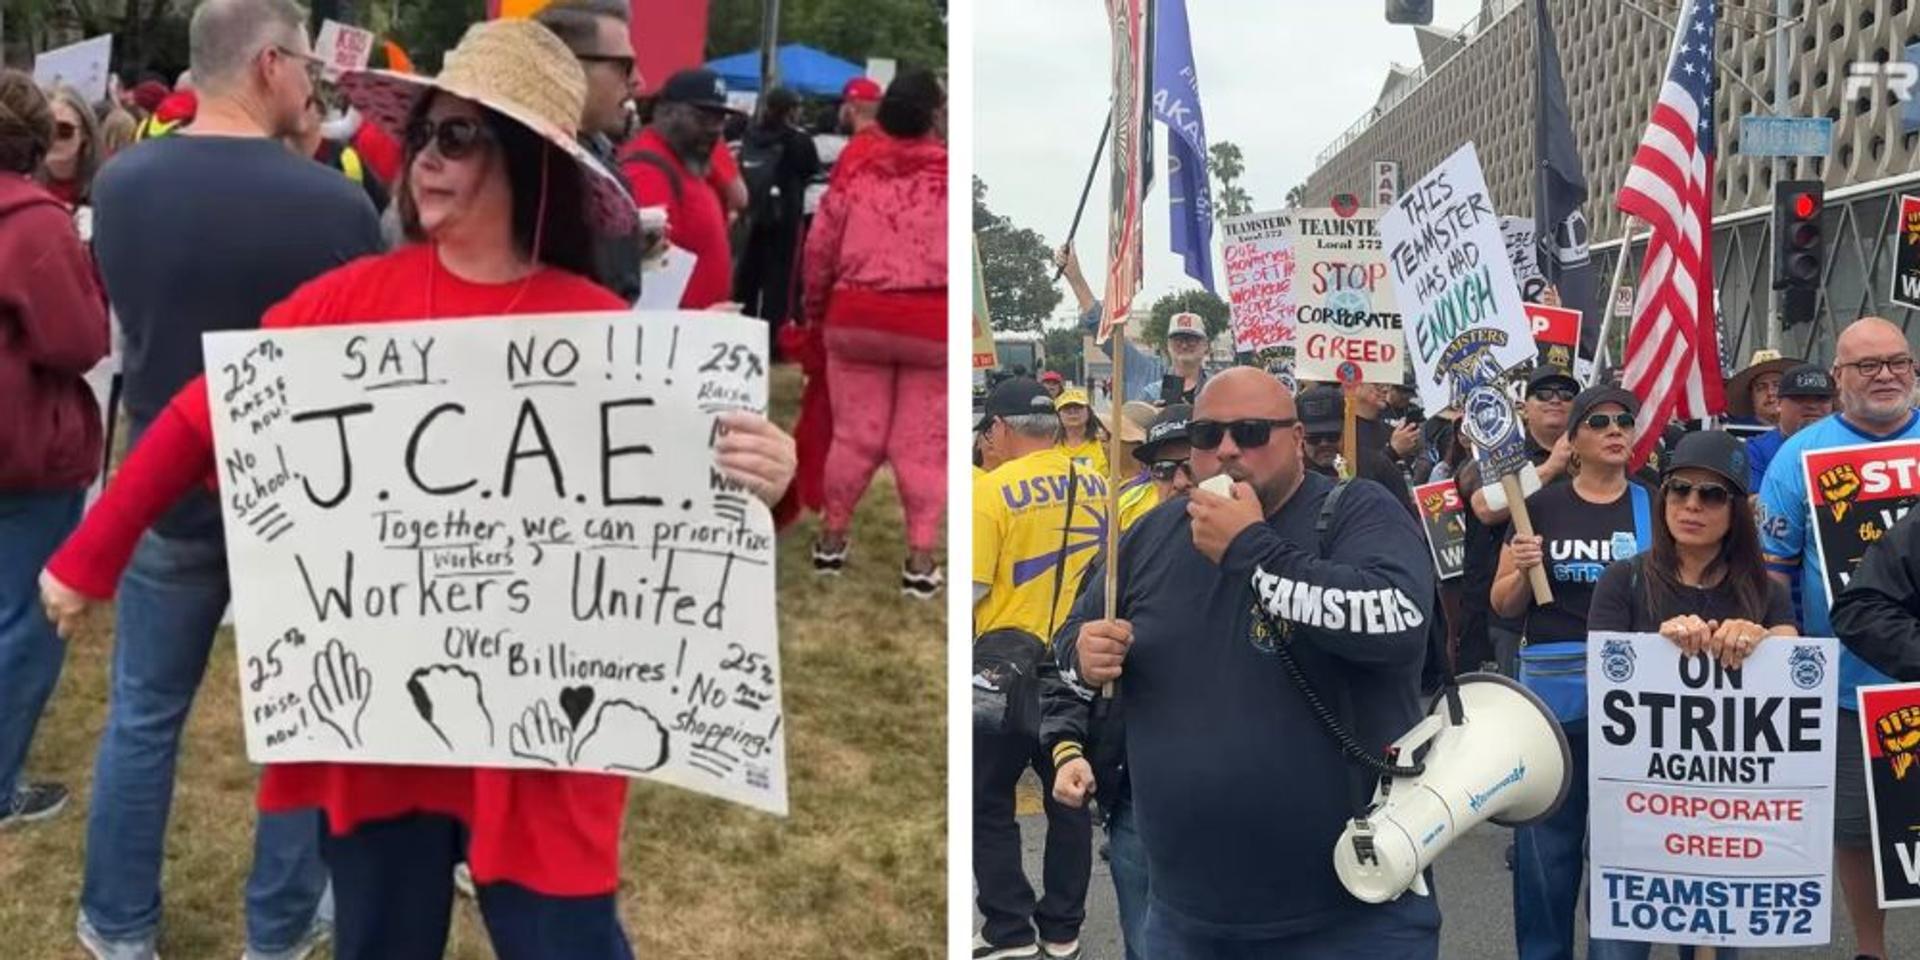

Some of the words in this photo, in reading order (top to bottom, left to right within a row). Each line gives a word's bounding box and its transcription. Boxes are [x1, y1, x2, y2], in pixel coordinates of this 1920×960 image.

[1379, 163, 1393, 205] PAR
[1400, 171, 1453, 226] THIS
[1225, 215, 1292, 236] TEAMSTERS
[1300, 218, 1381, 238] TEAMSTE
[1391, 192, 1492, 286] TEAMSTER
[1317, 239, 1352, 250] Local
[1356, 238, 1383, 250] 572
[1312, 260, 1387, 296] STOP
[1415, 265, 1447, 306] HAS
[1447, 241, 1480, 280] HAD
[1297, 304, 1402, 330] CORPORATE
[1415, 264, 1498, 363] ENOUGH
[342, 335, 435, 381] SAY
[1306, 333, 1396, 363] GREED
[226, 448, 256, 486] No
[291, 397, 692, 510] J.C.A.E.
[1860, 458, 1920, 493] ST
[522, 516, 573, 543] we
[584, 515, 635, 542] can
[653, 510, 771, 560] prioritize
[1859, 521, 1882, 542] the
[1551, 539, 1611, 561] UNI
[294, 547, 530, 622] Workers
[571, 549, 734, 630] United
[1553, 561, 1606, 583] STR
[508, 636, 687, 695] Billionaires!
[1678, 648, 1743, 690] ON
[688, 672, 726, 709] No
[1601, 689, 1822, 752] STRIKE
[1647, 752, 1775, 784] AGAINST
[1626, 791, 1804, 822] CORPORATE
[1664, 833, 1763, 860] GREED
[1602, 873, 1822, 908] TEAMSTERS
[1611, 902, 1736, 936] LOCAL
[1748, 908, 1813, 936] 572
